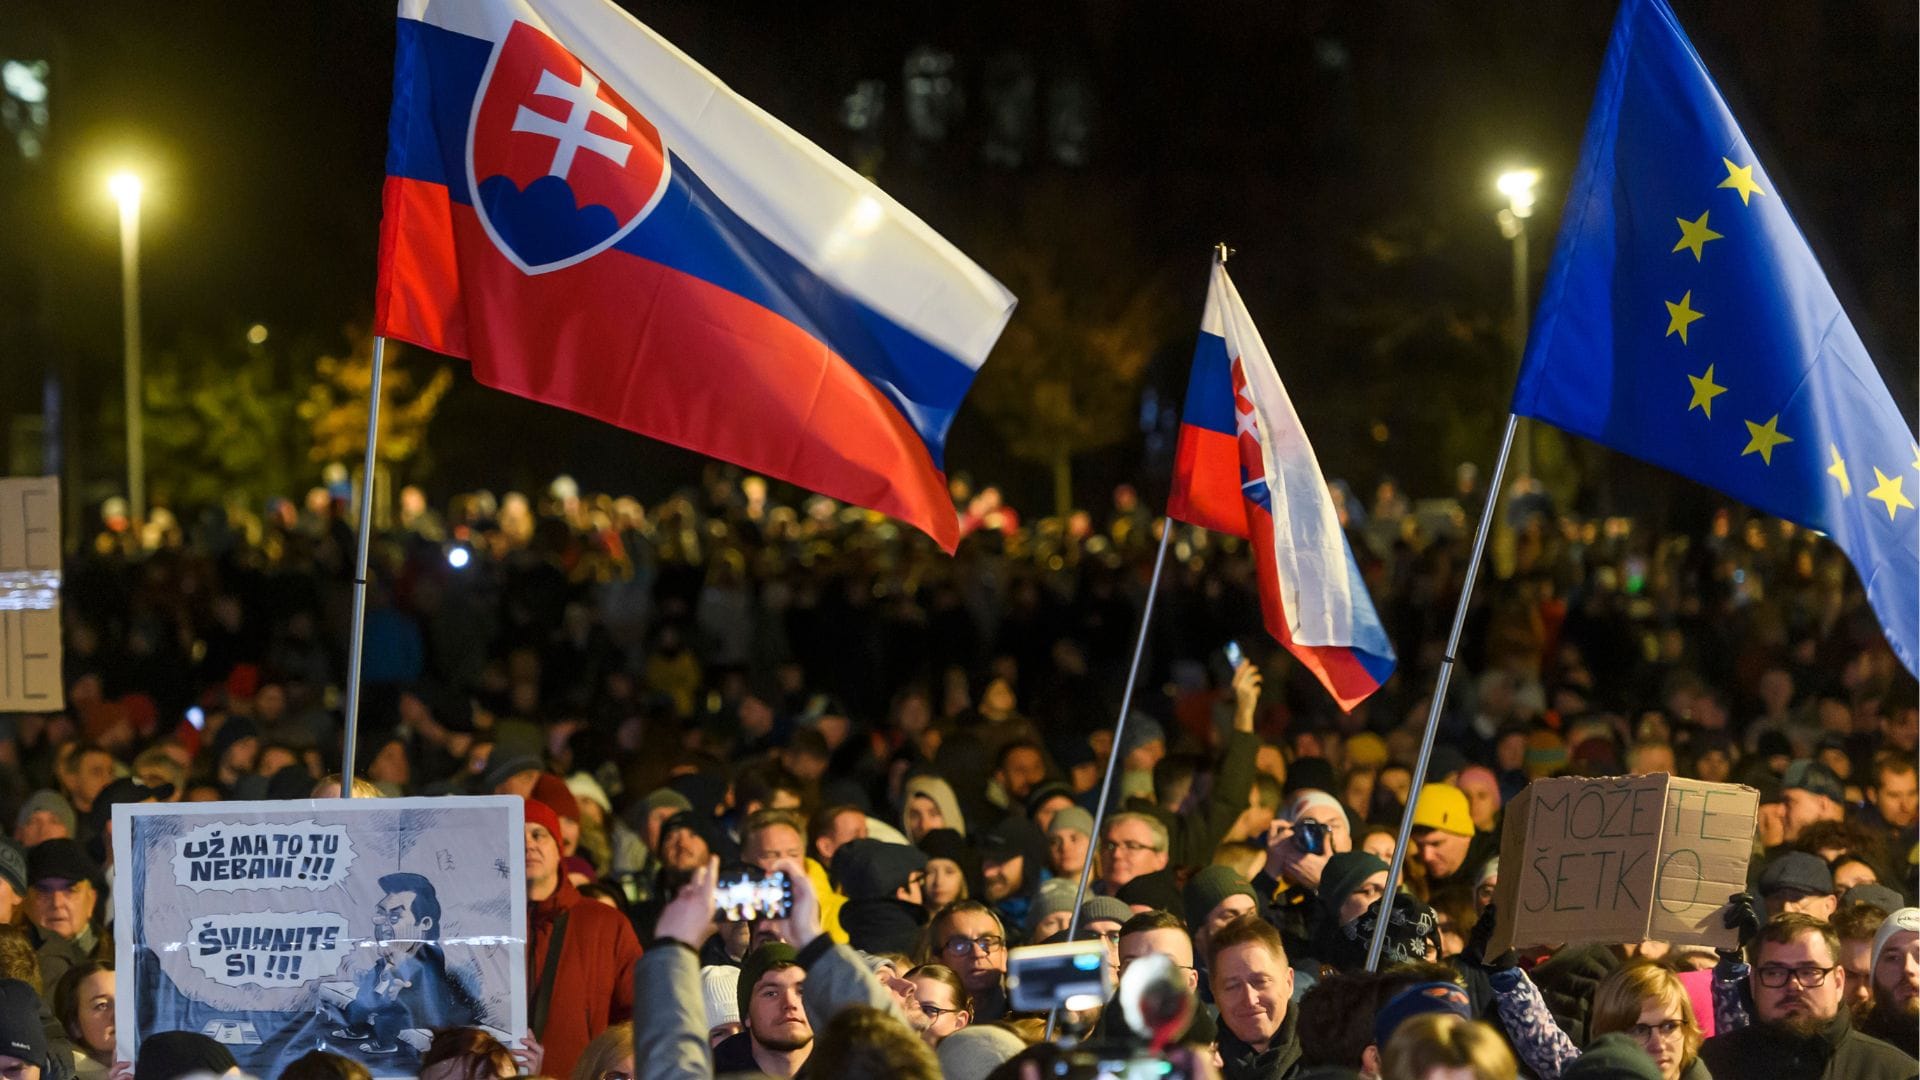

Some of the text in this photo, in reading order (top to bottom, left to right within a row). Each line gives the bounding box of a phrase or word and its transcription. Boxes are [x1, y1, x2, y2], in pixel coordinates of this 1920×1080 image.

[1532, 781, 1737, 842] MÔŽETE
[183, 830, 339, 859] UŽ MA TO TU
[190, 855, 336, 882] NEBAVÍ !!!
[1523, 847, 1701, 914] ŠETKO
[198, 921, 341, 956] ŠVIHNITE
[225, 953, 303, 980] SI !!!
